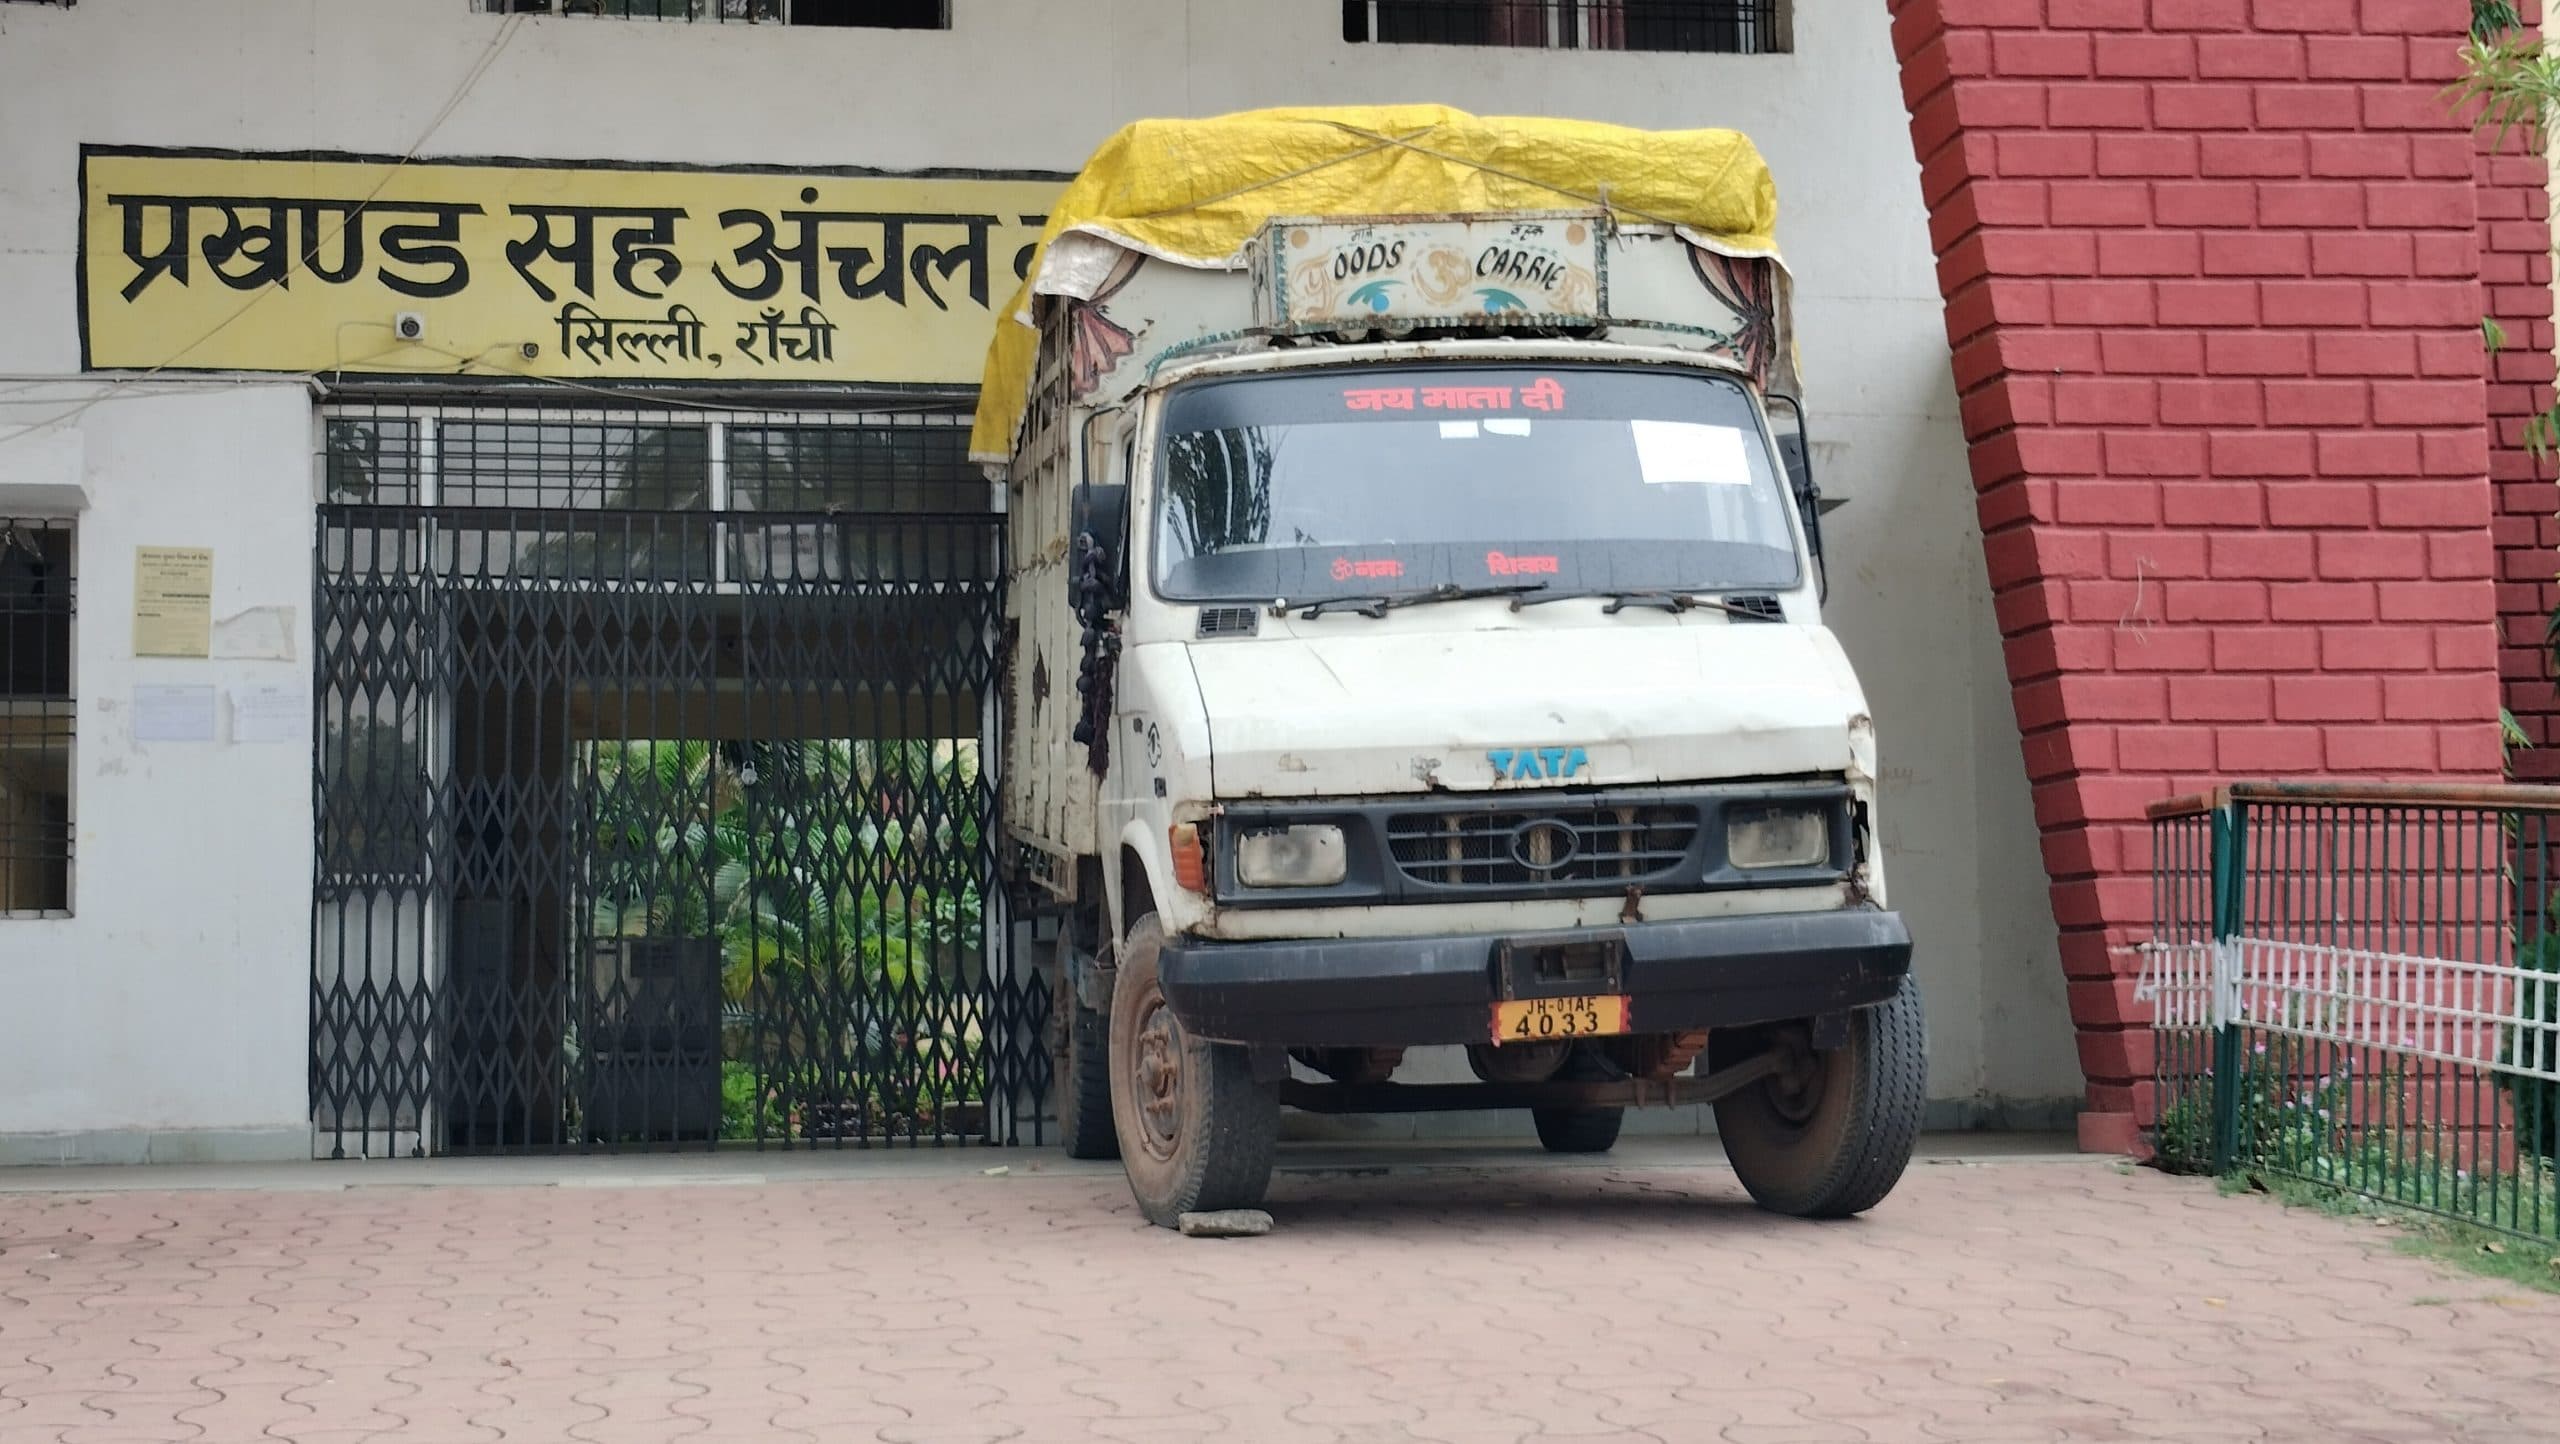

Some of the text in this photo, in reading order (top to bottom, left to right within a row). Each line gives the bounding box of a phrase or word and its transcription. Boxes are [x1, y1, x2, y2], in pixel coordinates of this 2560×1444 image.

[107, 193, 487, 303] प्रखण्ड
[505, 204, 690, 302] सह
[711, 187, 1002, 312] अंचल
[554, 301, 839, 368] सिल्ली, राँची
[1343, 377, 1565, 411] जय माता दी
[1485, 550, 1559, 576] शिवाय
[1486, 746, 1589, 780] TATA
[1527, 996, 1597, 1015] JH-01AF
[1516, 1011, 1599, 1036] 4033
